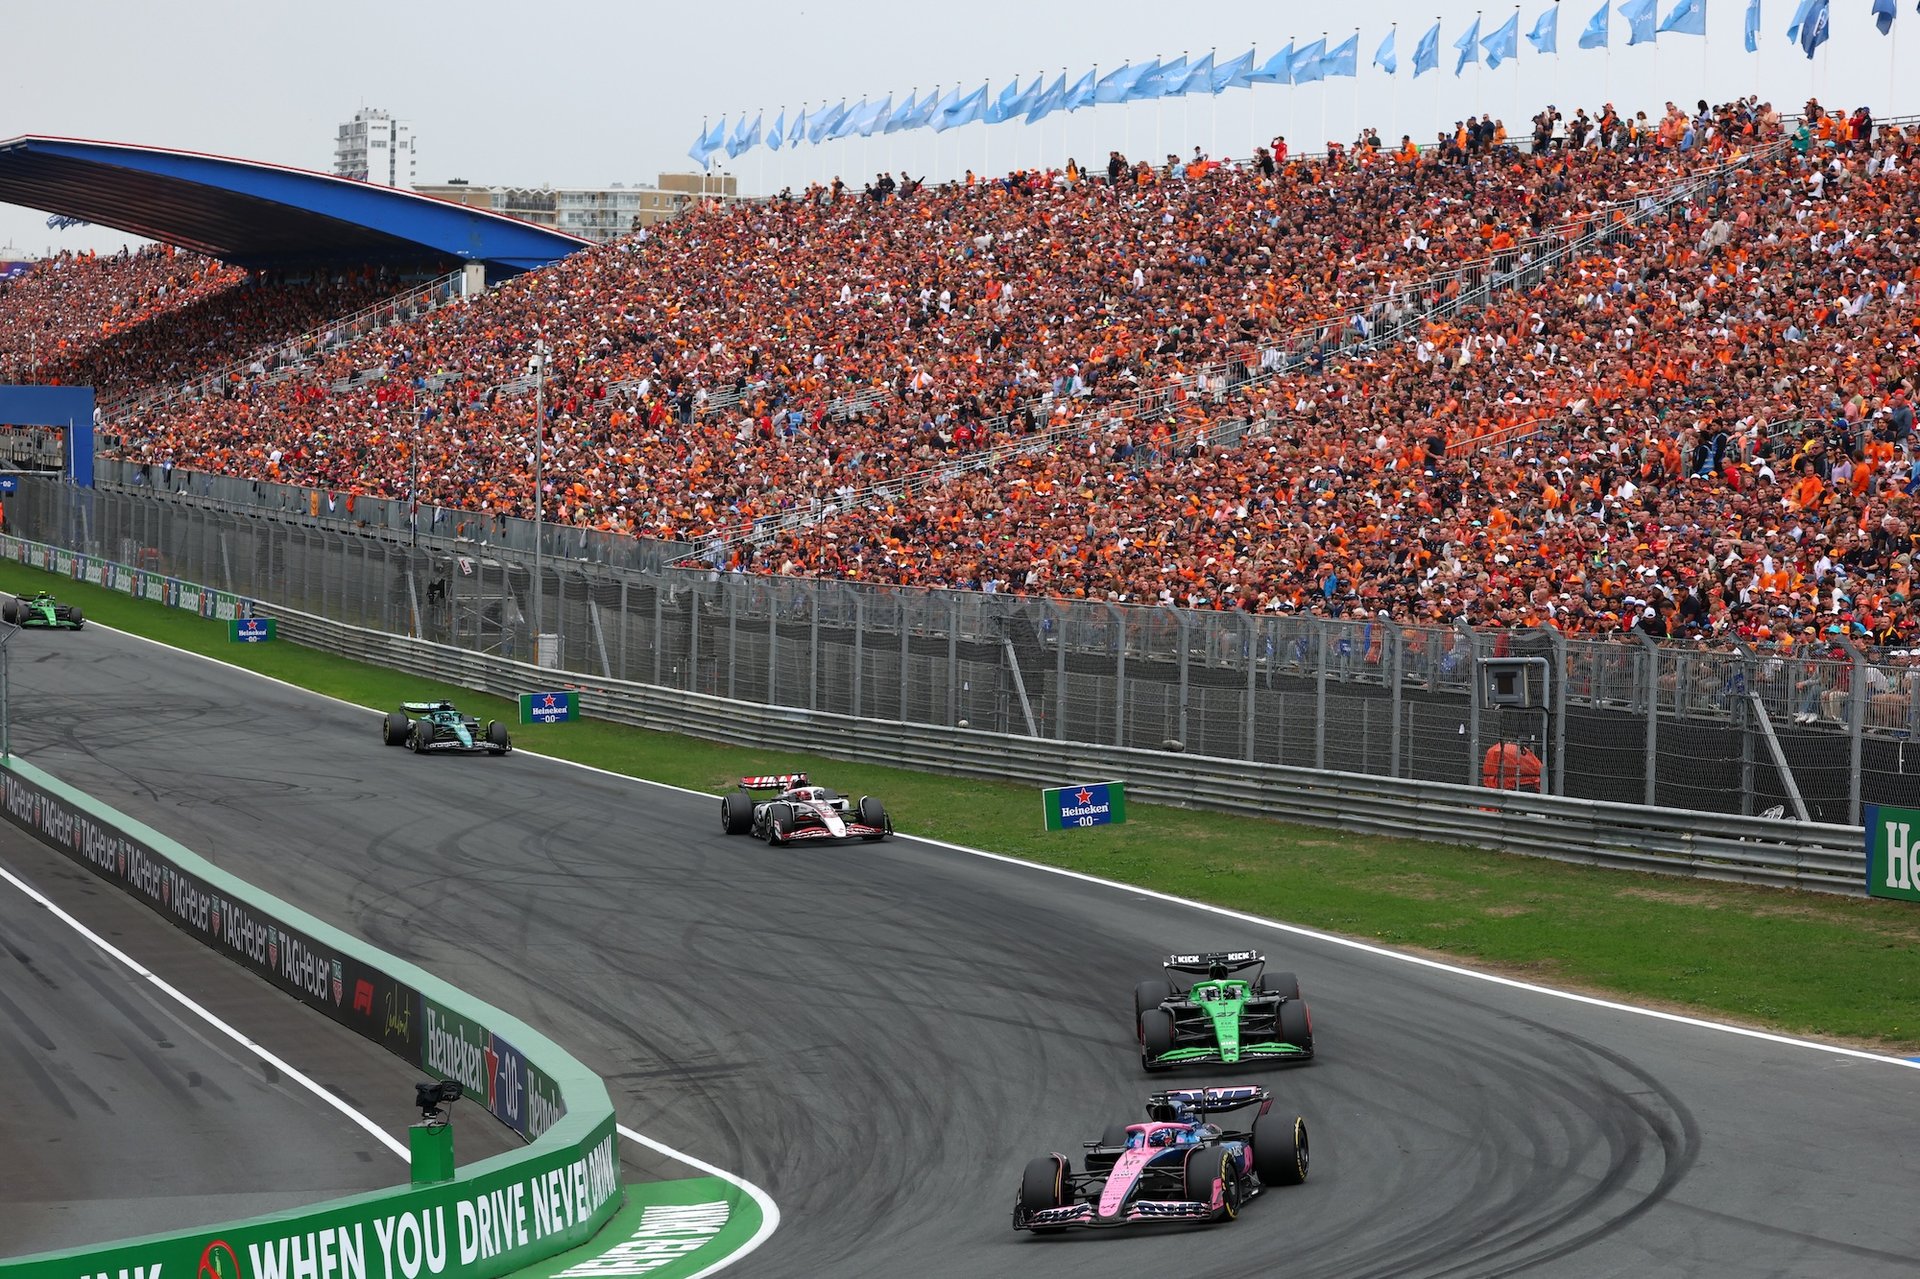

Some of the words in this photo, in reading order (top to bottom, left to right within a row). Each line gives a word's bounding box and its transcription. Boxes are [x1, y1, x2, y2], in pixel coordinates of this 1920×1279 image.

[532, 706, 567, 715] Heineken
[1062, 804, 1109, 818] Heineken
[1178, 956, 1199, 964] KICK
[1228, 952, 1250, 961] KICK
[426, 1007, 483, 1094] Heineken
[373, 1205, 447, 1279] YOU
[456, 1182, 528, 1266] DRIVE
[531, 1158, 592, 1240] NEVER
[588, 1134, 616, 1211] DRINK
[630, 1200, 730, 1238] DRINK
[549, 1236, 714, 1278] NEVER
